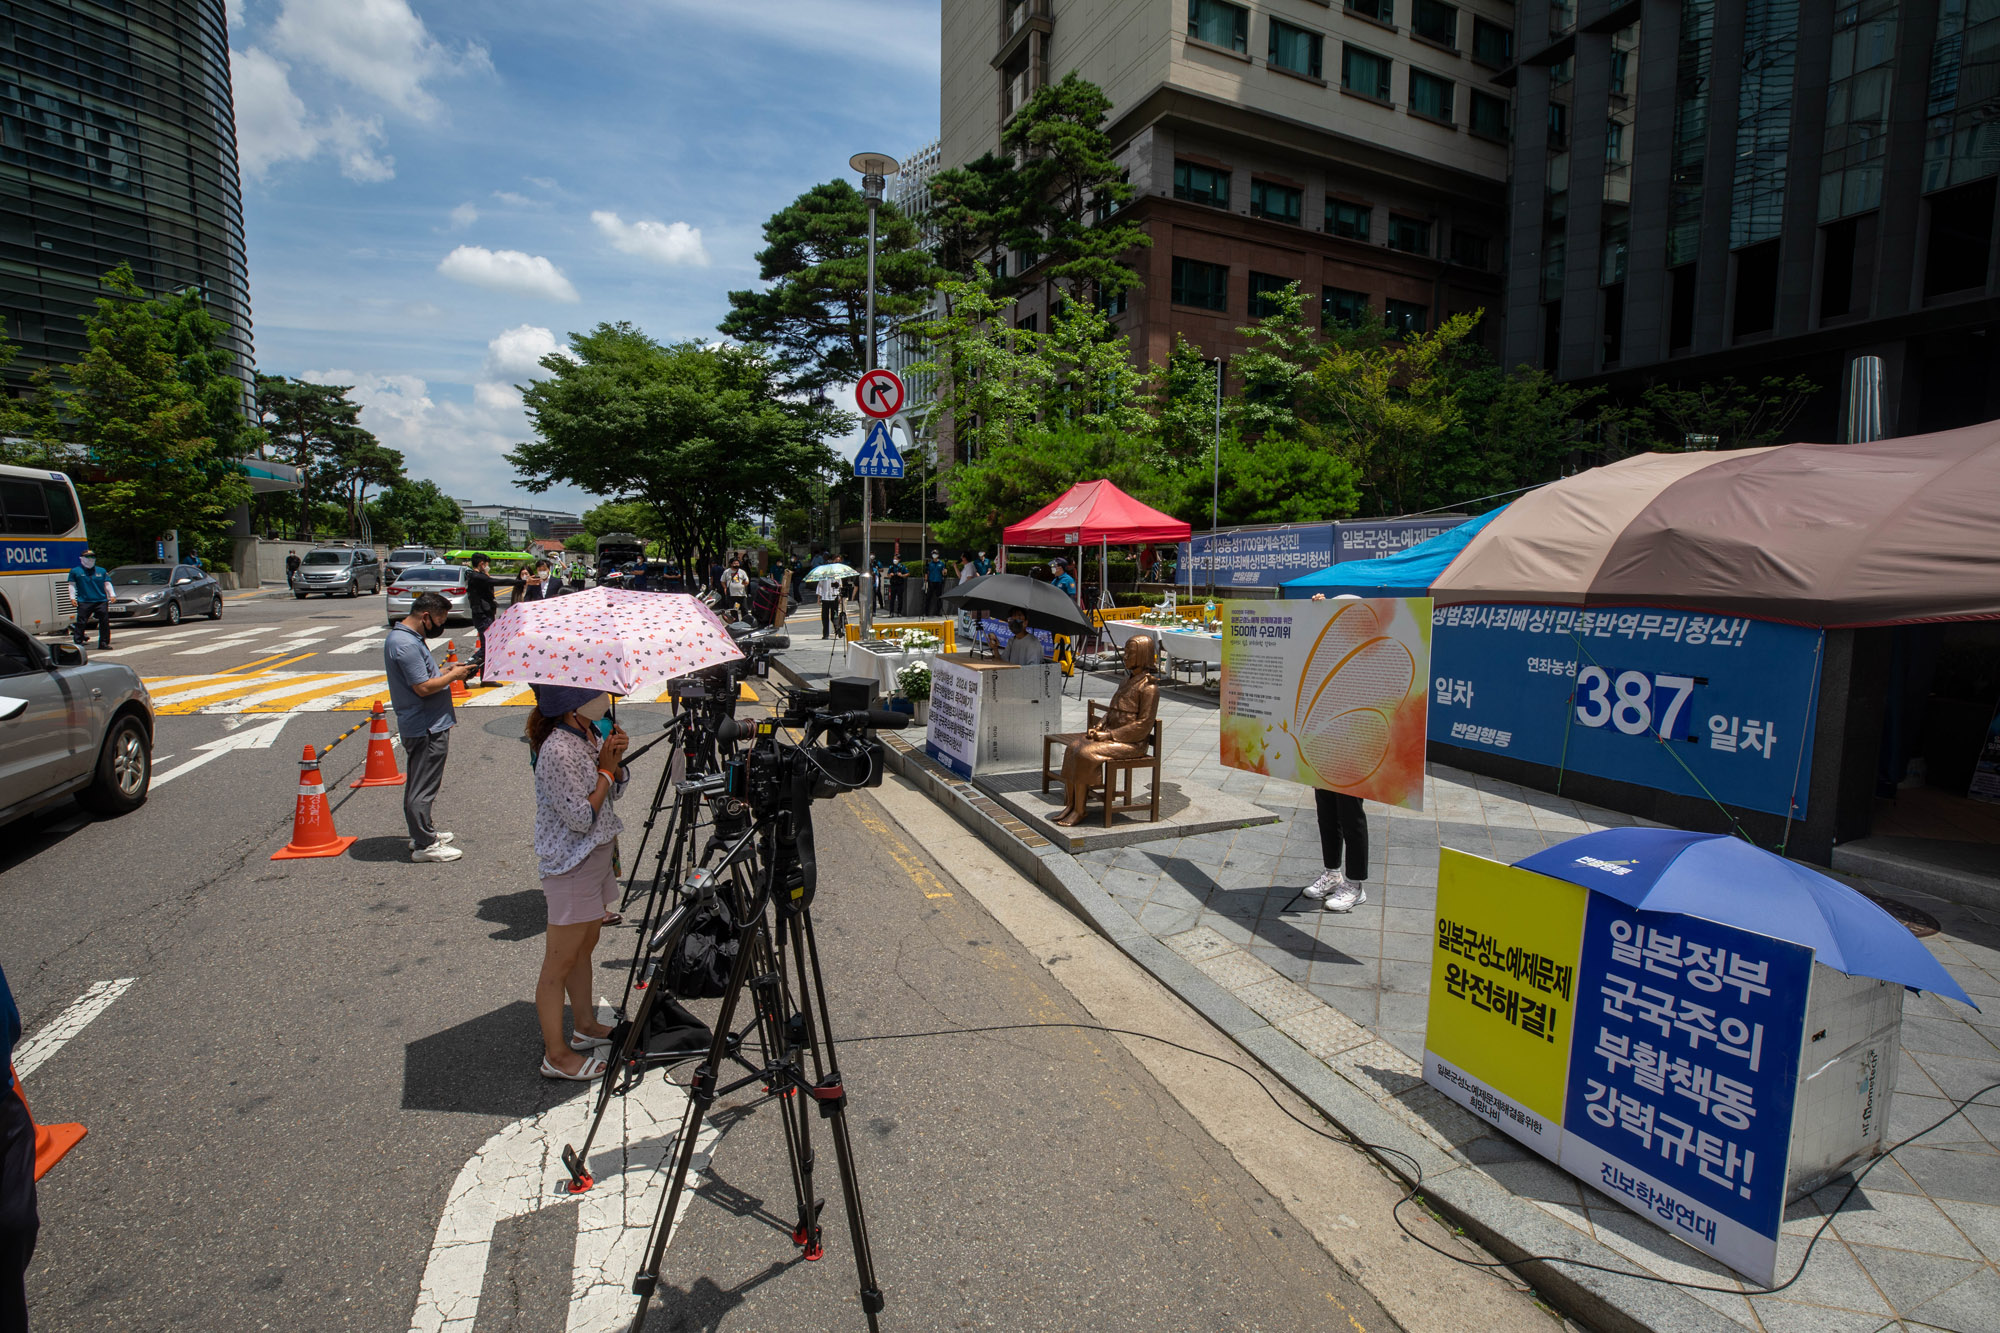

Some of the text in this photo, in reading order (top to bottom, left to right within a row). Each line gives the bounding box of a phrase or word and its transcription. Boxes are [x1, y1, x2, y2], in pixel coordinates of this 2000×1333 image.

[860, 466, 899, 476] 횡단보도
[6, 547, 48, 564] POLICE
[1231, 625, 1290, 639] 1500차 수요시위
[1435, 677, 1474, 708] 일차
[1527, 657, 1776, 760] 연좌농성 387 일차
[1450, 722, 1512, 748] 반일행동
[1437, 917, 1572, 1002] 일본군성노예제문제
[1609, 920, 1772, 1005] 일본정부
[1444, 962, 1556, 1044] 완전해결!
[1600, 974, 1763, 1072] 군국주의
[1437, 1063, 1543, 1136] 일본군성노예제문제해결을위한
[1470, 1095, 1500, 1123] 희망나비
[1594, 1027, 1756, 1132] 부활책동
[1584, 1078, 1755, 1200] 강력규탄!
[1599, 1160, 1717, 1246] 진보학생연대
